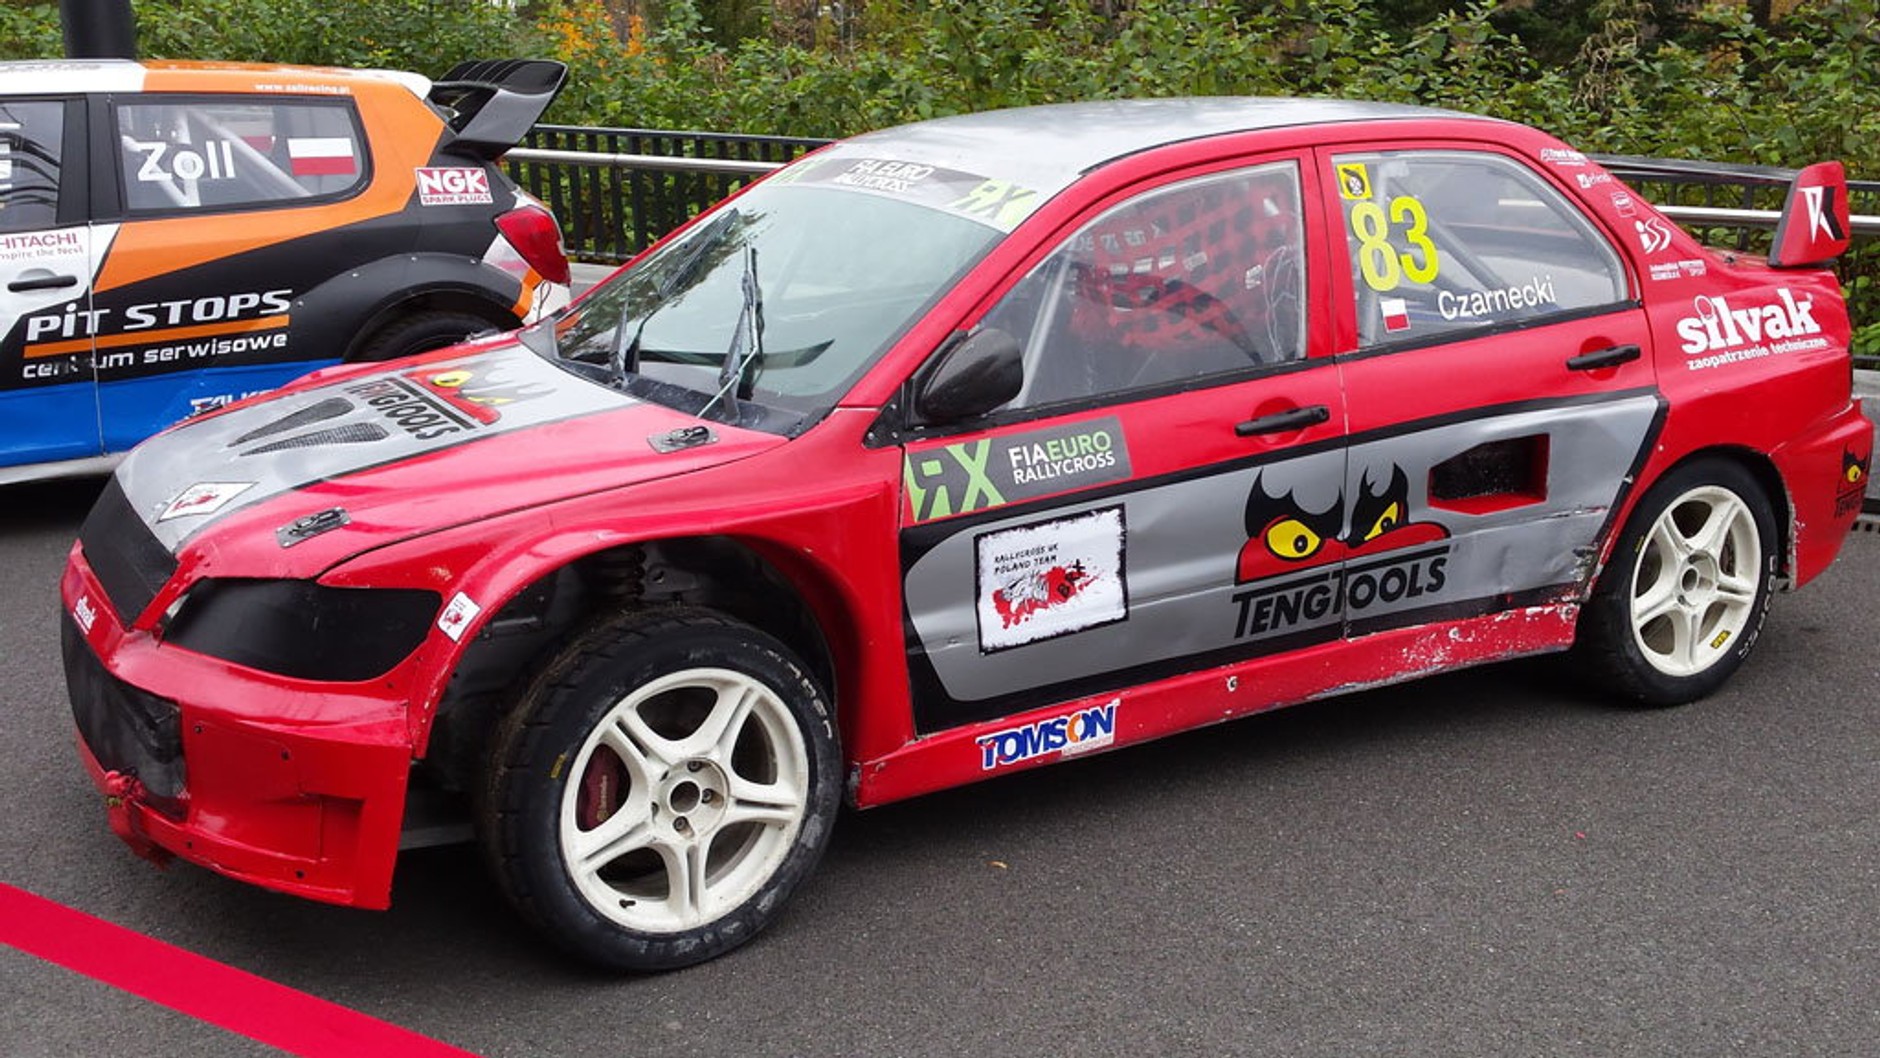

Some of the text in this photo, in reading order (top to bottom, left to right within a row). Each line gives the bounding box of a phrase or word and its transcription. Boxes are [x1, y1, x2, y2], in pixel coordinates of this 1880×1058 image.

[138, 140, 236, 182] Zoll
[418, 169, 489, 194] NGK
[1351, 195, 1440, 292] 83
[123, 289, 293, 331] STOPS
[1438, 274, 1557, 320] Czarnecki
[1676, 288, 1822, 355] silvak
[143, 333, 288, 364] serwisowe
[1686, 343, 1770, 371] zaopatrzenie
[1013, 450, 1116, 485] RALLYCROSS
[994, 545, 1046, 563] RALLYCROSS
[994, 554, 1057, 575] POLAND TEAM
[1231, 546, 1451, 639] TENGTOOLS
[976, 704, 1115, 769] TOMSON
